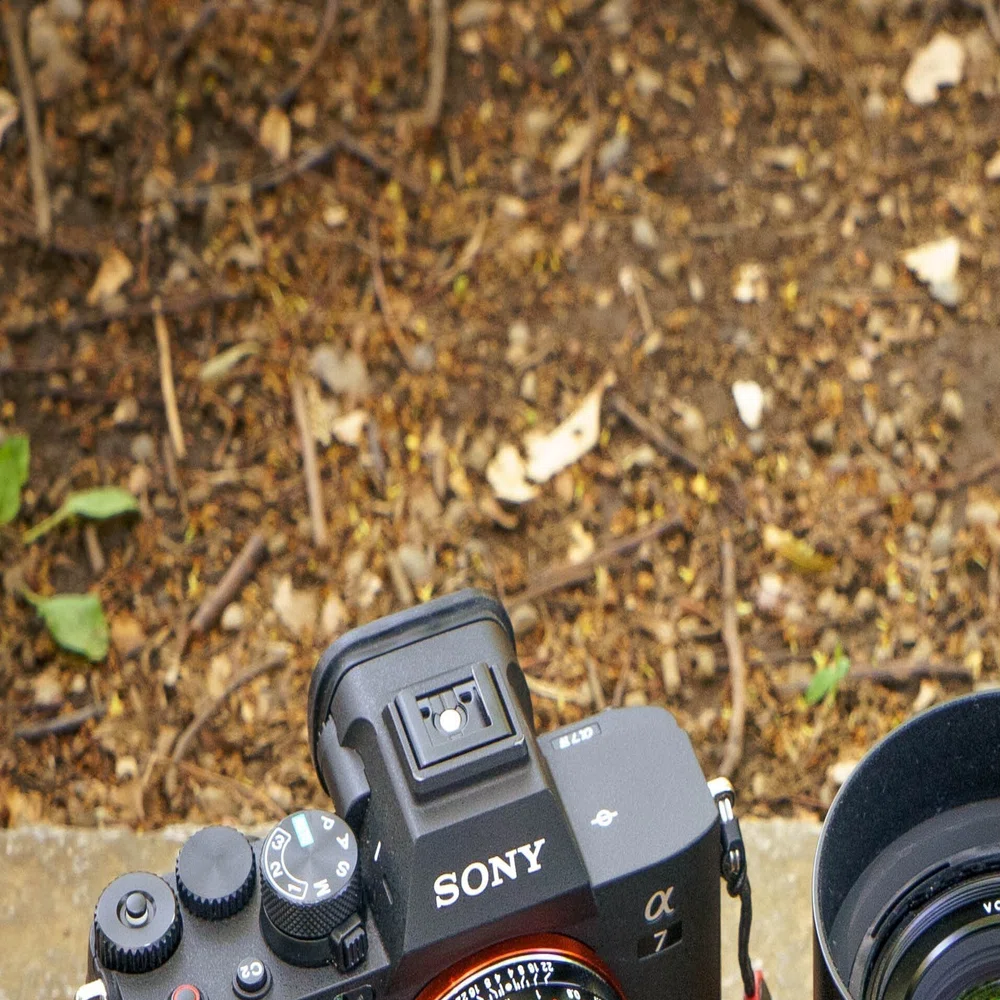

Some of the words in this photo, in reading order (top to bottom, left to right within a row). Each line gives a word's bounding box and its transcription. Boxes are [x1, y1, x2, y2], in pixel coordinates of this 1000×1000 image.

[321, 815, 335, 830] P
[271, 834, 285, 850] 3
[336, 832, 350, 850] A
[270, 861, 283, 878] 2
[336, 860, 350, 877] S
[433, 839, 546, 909] SONY
[287, 883, 301, 893] 1
[313, 878, 331, 898] M
[653, 928, 670, 953] 7
[240, 961, 264, 979] C2
